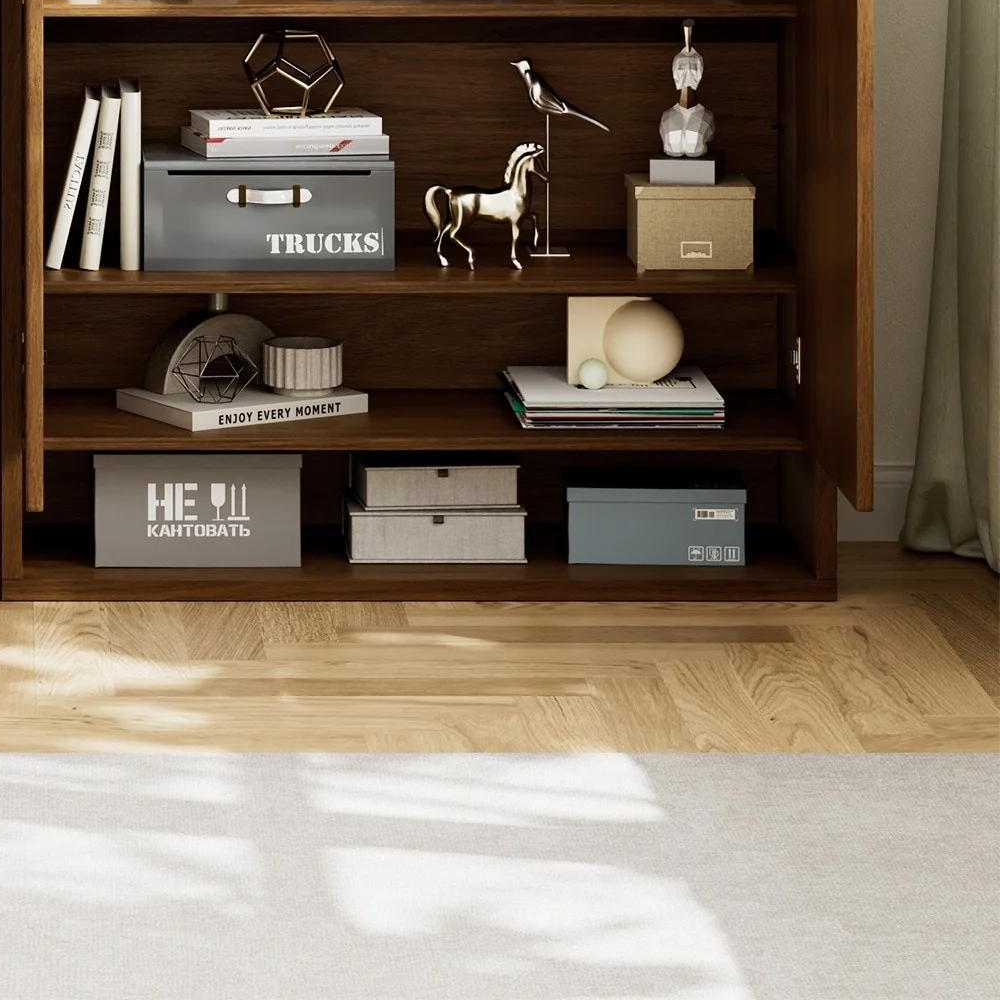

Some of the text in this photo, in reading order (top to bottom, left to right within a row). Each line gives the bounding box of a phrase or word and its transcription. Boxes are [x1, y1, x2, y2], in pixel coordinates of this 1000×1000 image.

[266, 231, 380, 255] TRUCKS
[218, 402, 342, 425] ENJOY EVERY MOMENT
[147, 482, 198, 521] НЕ
[147, 524, 251, 538] КАНТОВАТЬ
